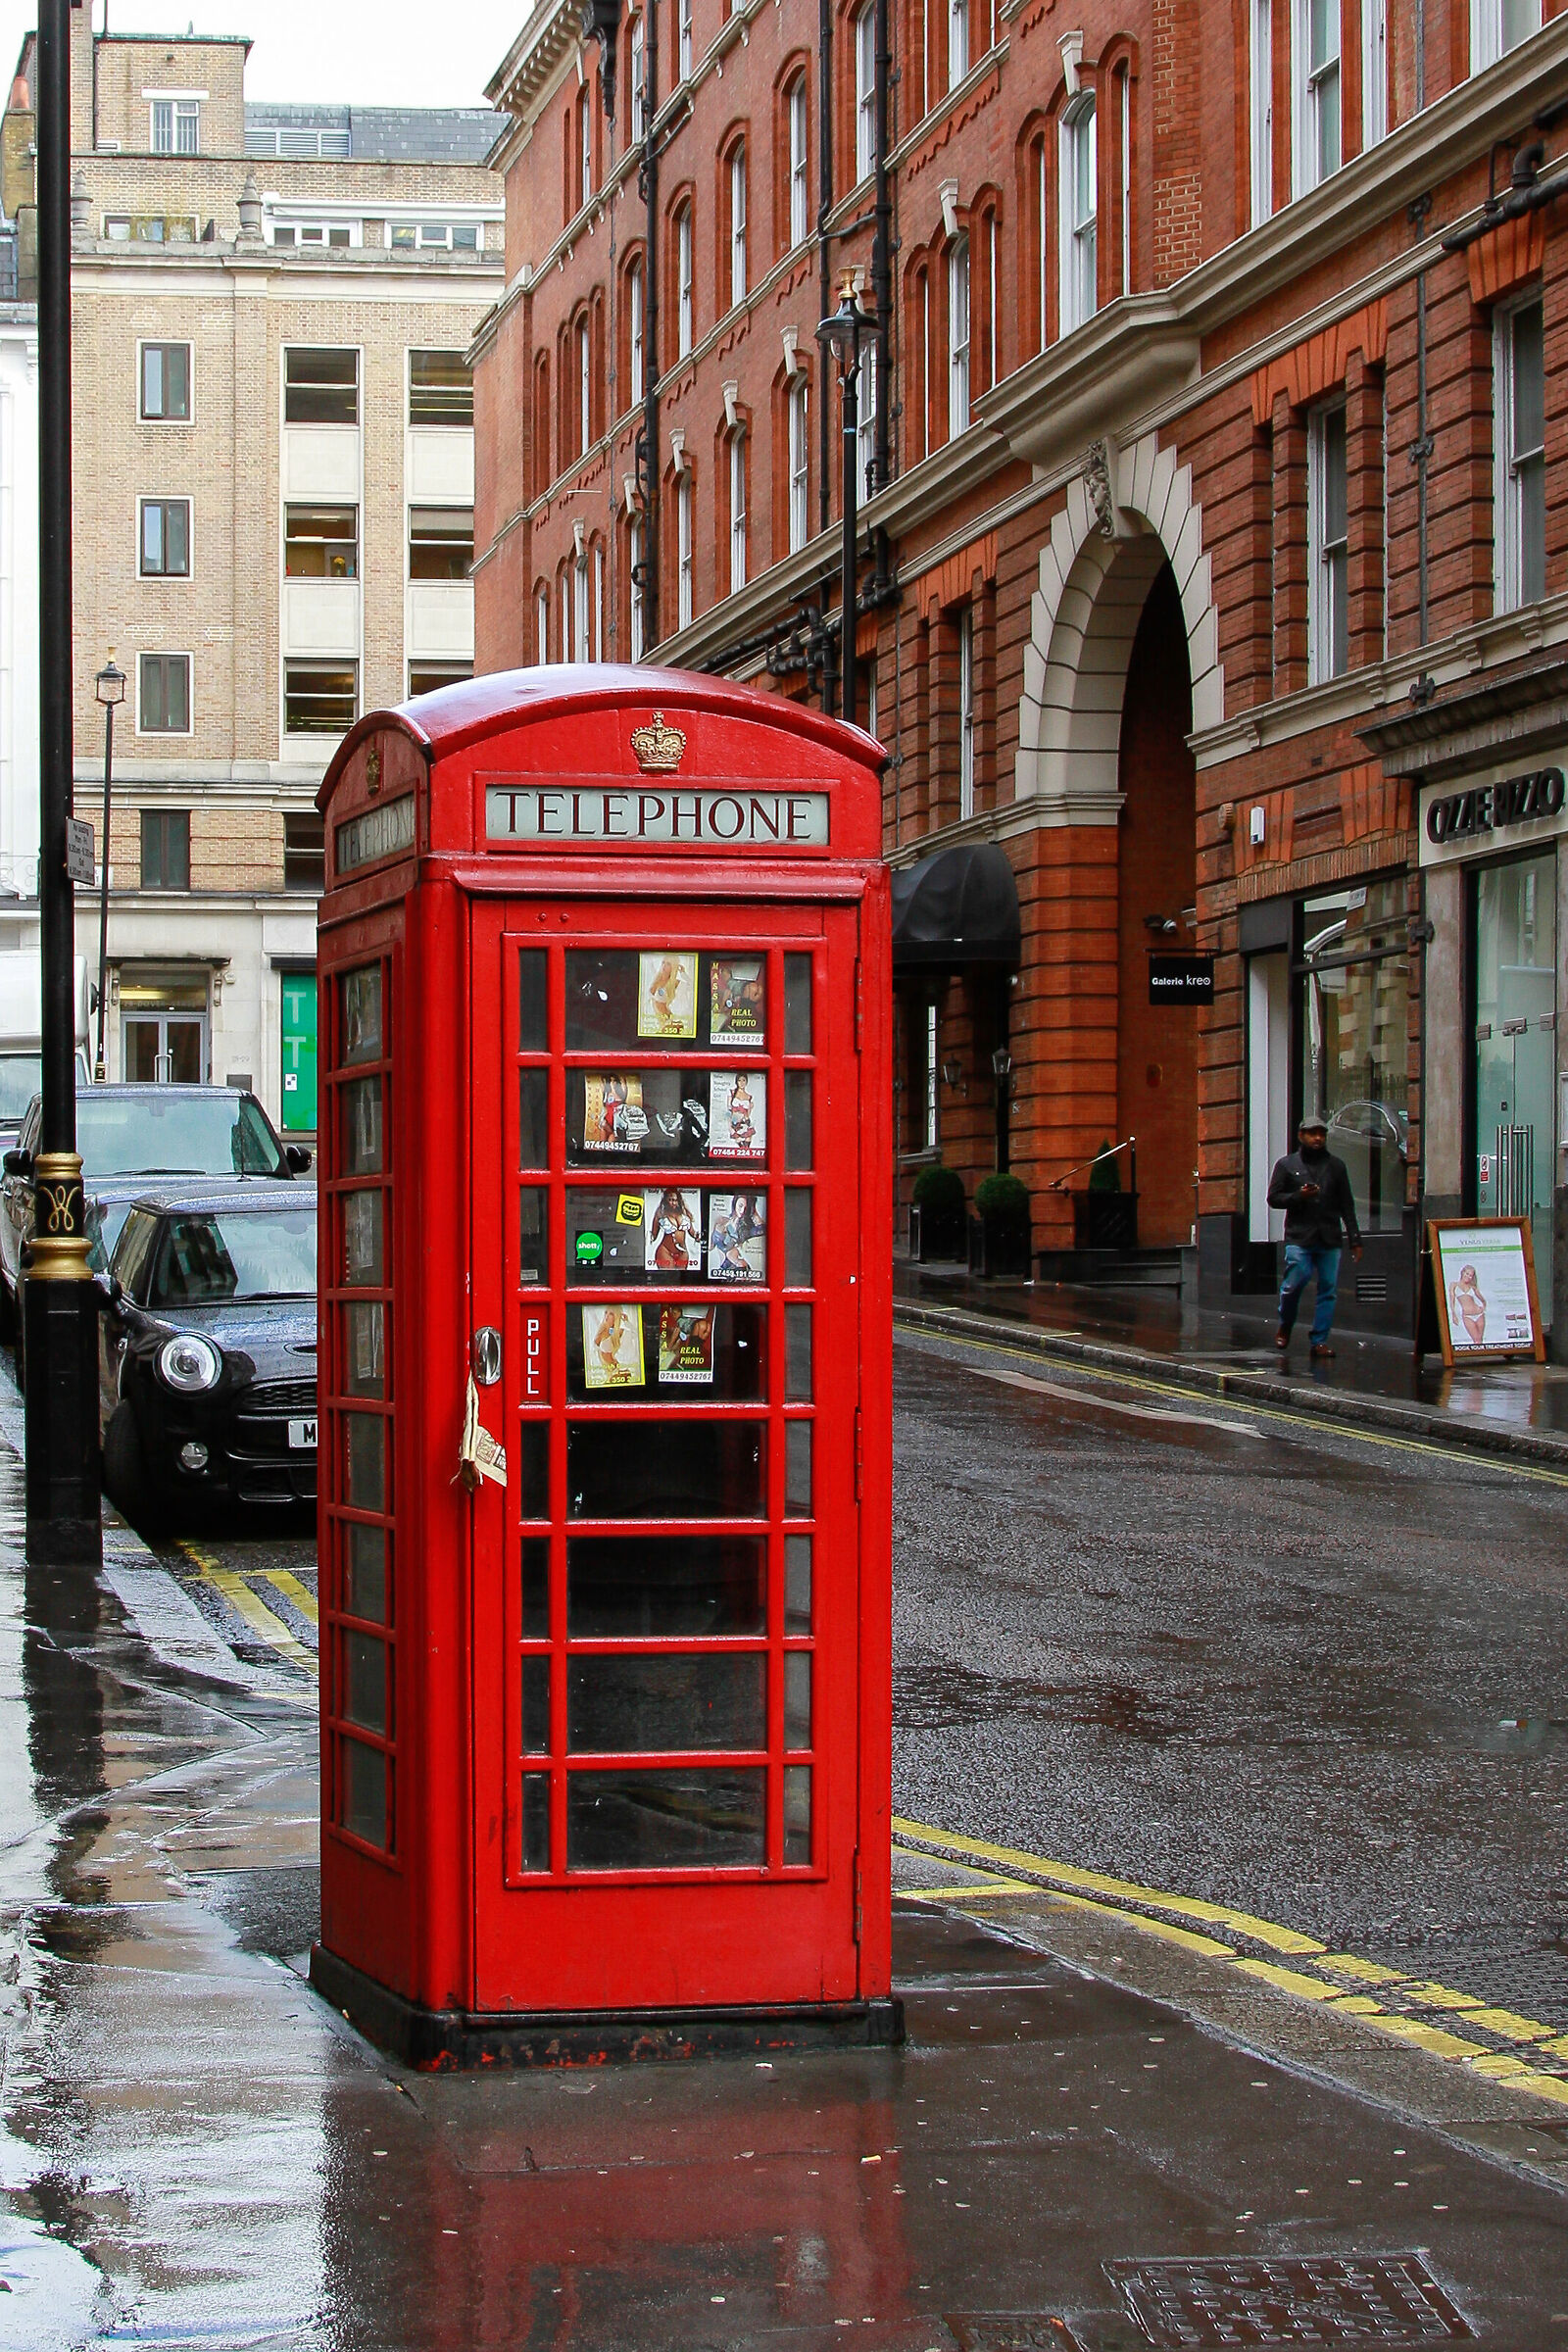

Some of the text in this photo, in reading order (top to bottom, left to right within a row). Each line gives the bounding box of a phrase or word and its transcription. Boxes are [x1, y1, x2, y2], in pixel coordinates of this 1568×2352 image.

[494, 791, 812, 840] TELEPHONE
[340, 799, 415, 867] TELEPHON
[1152, 974, 1211, 986] Galerie kreo
[711, 962, 720, 1031] MASSA
[731, 1008, 753, 1017] REAL
[731, 1018, 757, 1027] PHOTO
[585, 1141, 640, 1152] 07449452767
[680, 1346, 702, 1354] REAL
[527, 1319, 539, 1395] PULL
[680, 1355, 705, 1365] PHOTO
[660, 1372, 712, 1381] 07449452767
